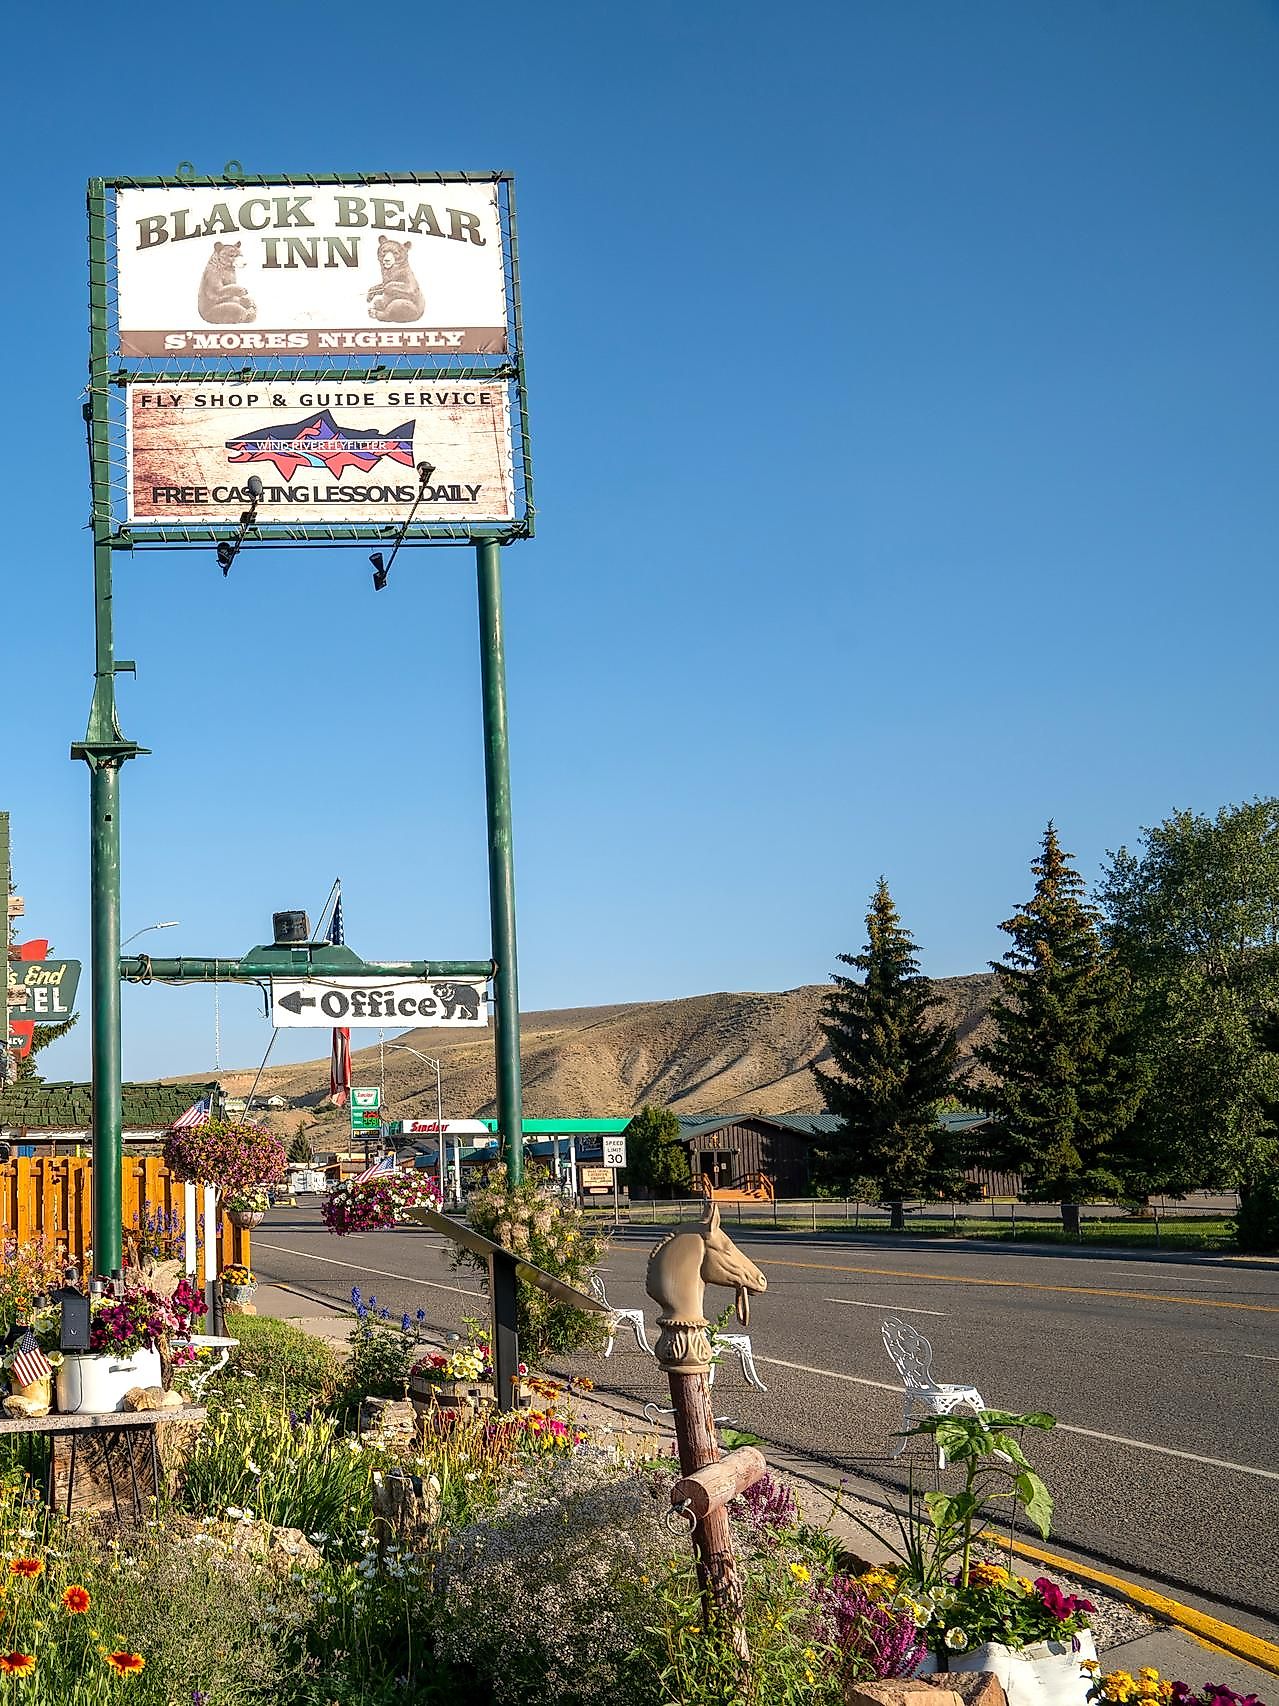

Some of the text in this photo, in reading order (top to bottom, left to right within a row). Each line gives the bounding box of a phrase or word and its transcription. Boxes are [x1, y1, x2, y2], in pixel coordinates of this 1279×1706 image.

[135, 196, 487, 250] BLACK BEAR
[261, 236, 361, 269] INN
[164, 330, 465, 350] S'MORES NIGHTLY
[141, 392, 491, 408] FLY SHOP & GUIDE SERVICE
[256, 441, 289, 450] WIND
[292, 441, 325, 450] RIVER
[152, 486, 208, 503] FREE
[313, 485, 415, 503] LESSONS
[419, 484, 482, 502] DAILY
[24, 964, 67, 987] End
[320, 989, 438, 1019] Office
[607, 1154, 623, 1164] 30
